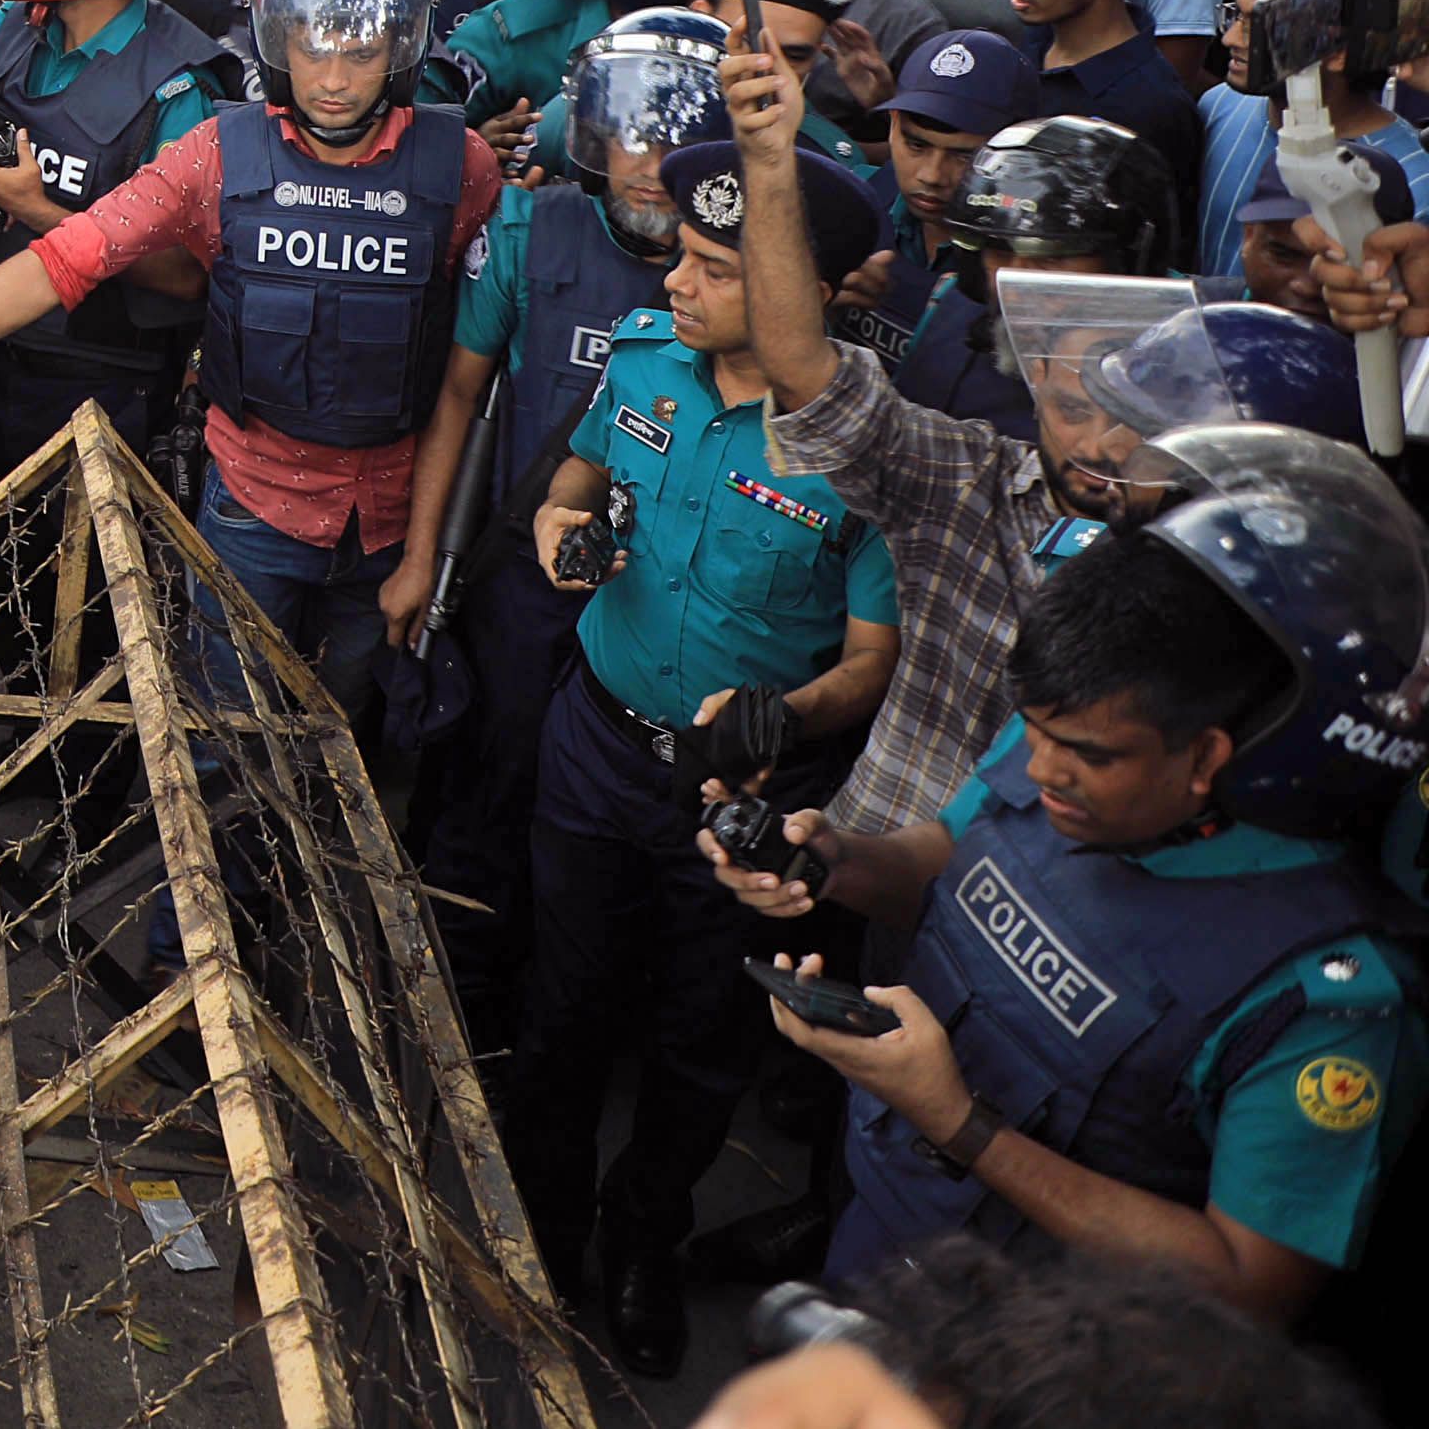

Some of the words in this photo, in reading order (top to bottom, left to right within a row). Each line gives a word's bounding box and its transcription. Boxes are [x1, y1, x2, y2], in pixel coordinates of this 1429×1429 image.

[300, 186, 317, 205] NIJ
[258, 226, 408, 275] POLICE
[969, 877, 1087, 1011] POLICE
